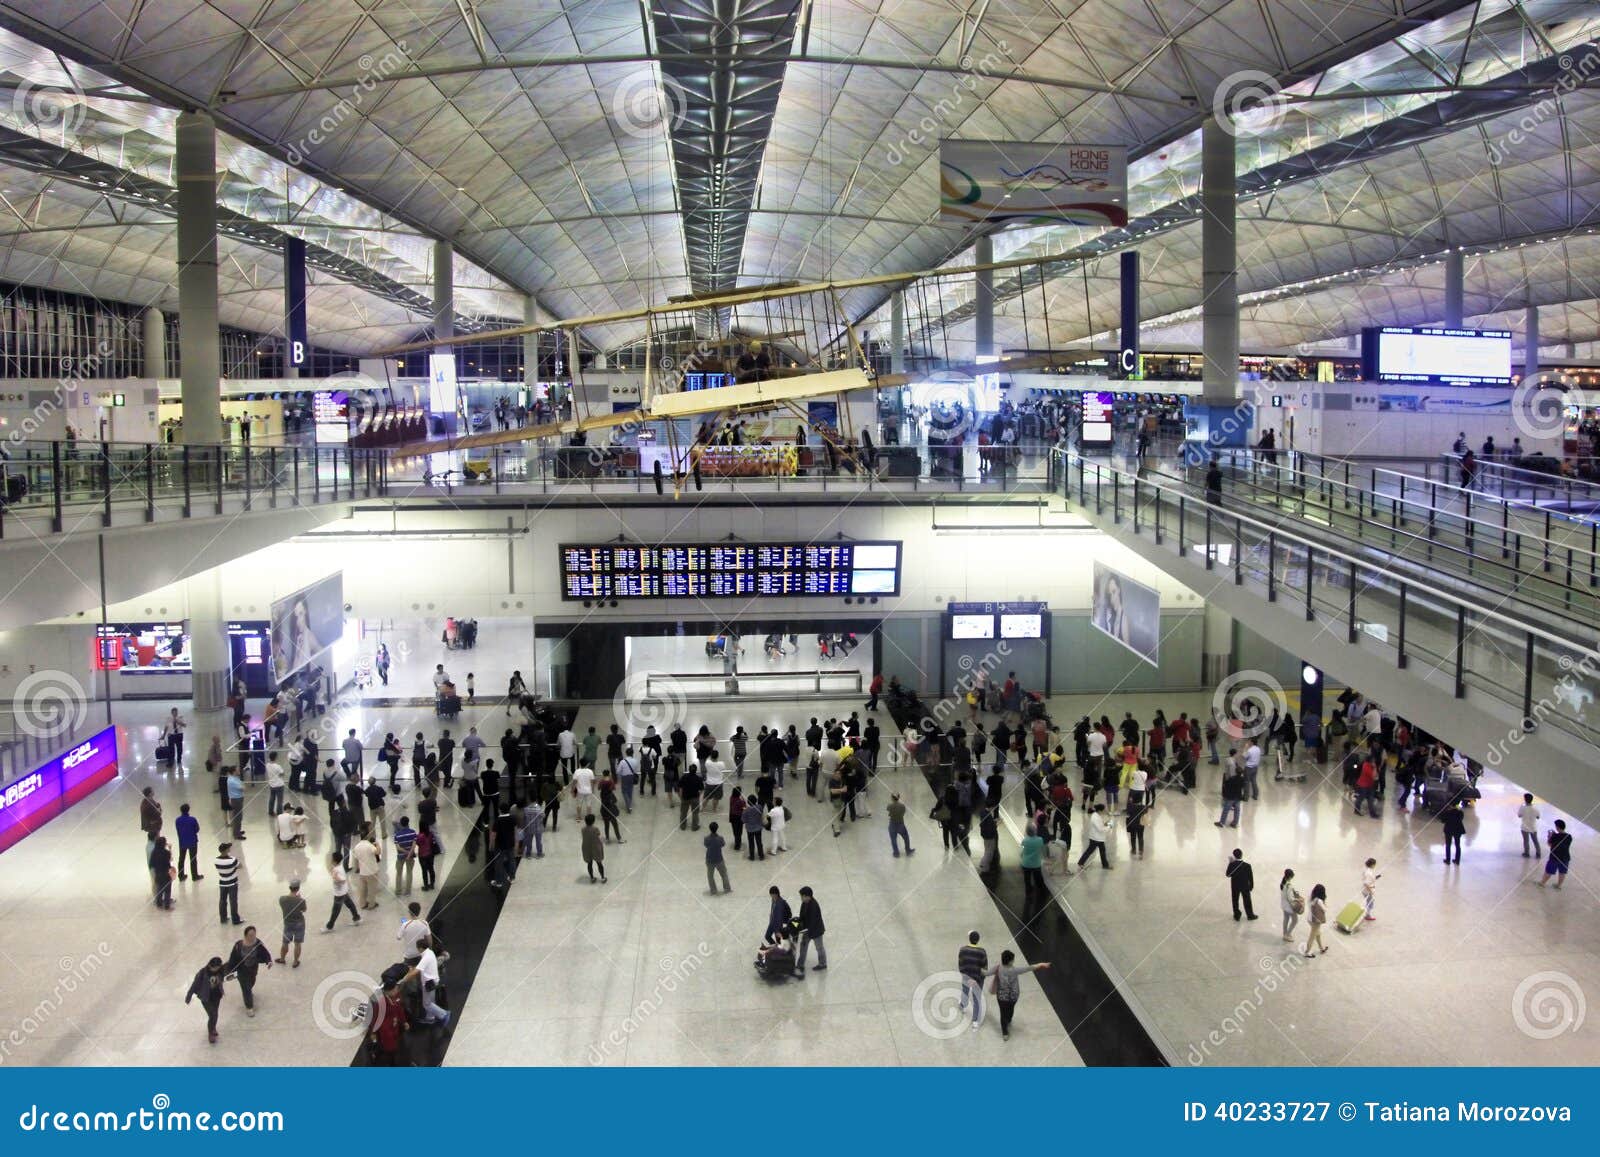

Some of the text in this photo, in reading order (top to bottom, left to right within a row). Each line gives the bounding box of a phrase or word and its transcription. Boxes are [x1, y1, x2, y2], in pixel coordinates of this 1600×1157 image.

[1071, 150, 1109, 160] HONG
[1071, 160, 1109, 170] KONG
[293, 341, 304, 363] B
[1122, 348, 1134, 370] C
